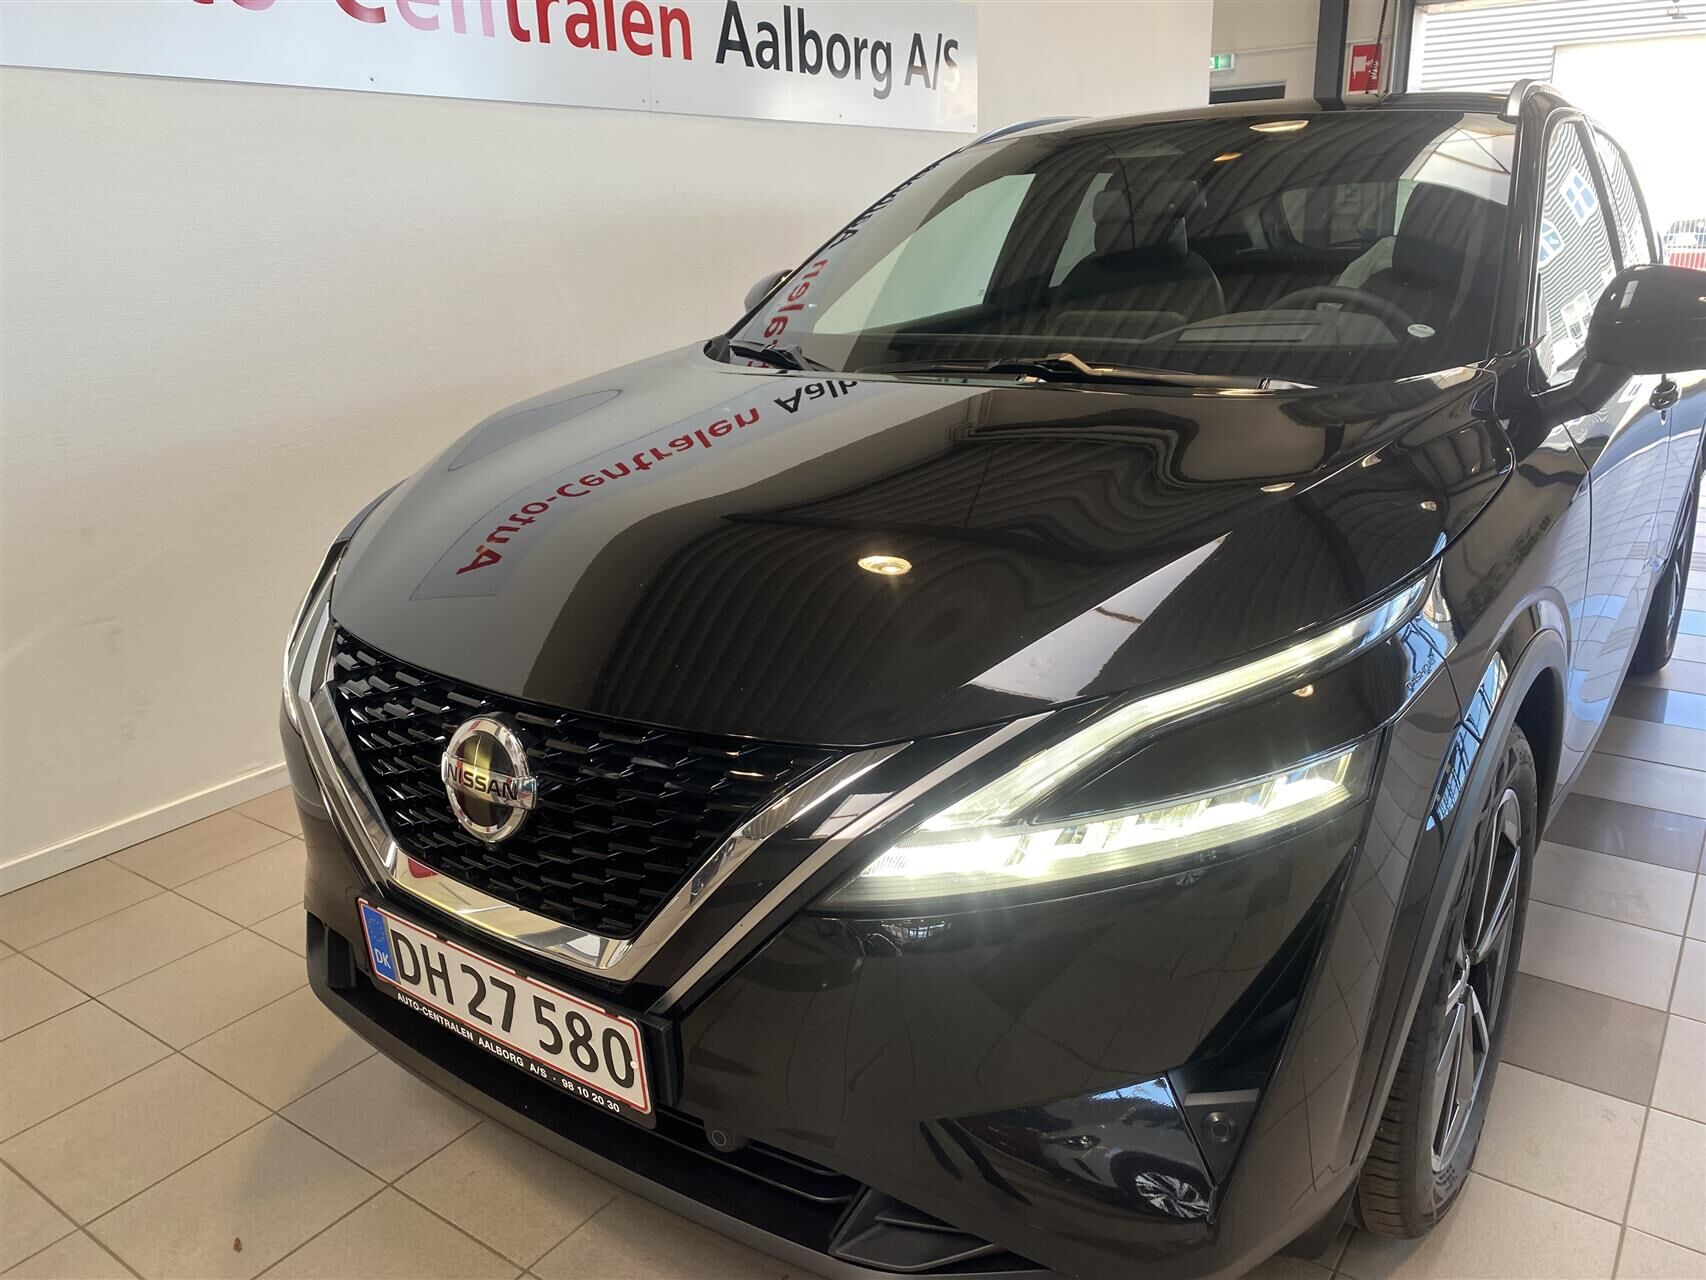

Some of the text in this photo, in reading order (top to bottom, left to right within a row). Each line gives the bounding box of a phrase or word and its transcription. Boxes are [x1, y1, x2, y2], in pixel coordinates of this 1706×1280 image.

[715, 0, 892, 100] Aalborg
[904, 32, 961, 91] A/S
[447, 761, 518, 801] NISSAN
[374, 948, 392, 969] DK
[390, 928, 635, 1089] DH 27 580
[397, 993, 621, 1114] AUTO-CENTRALEN AALBORG A/S 98 10 20 30
